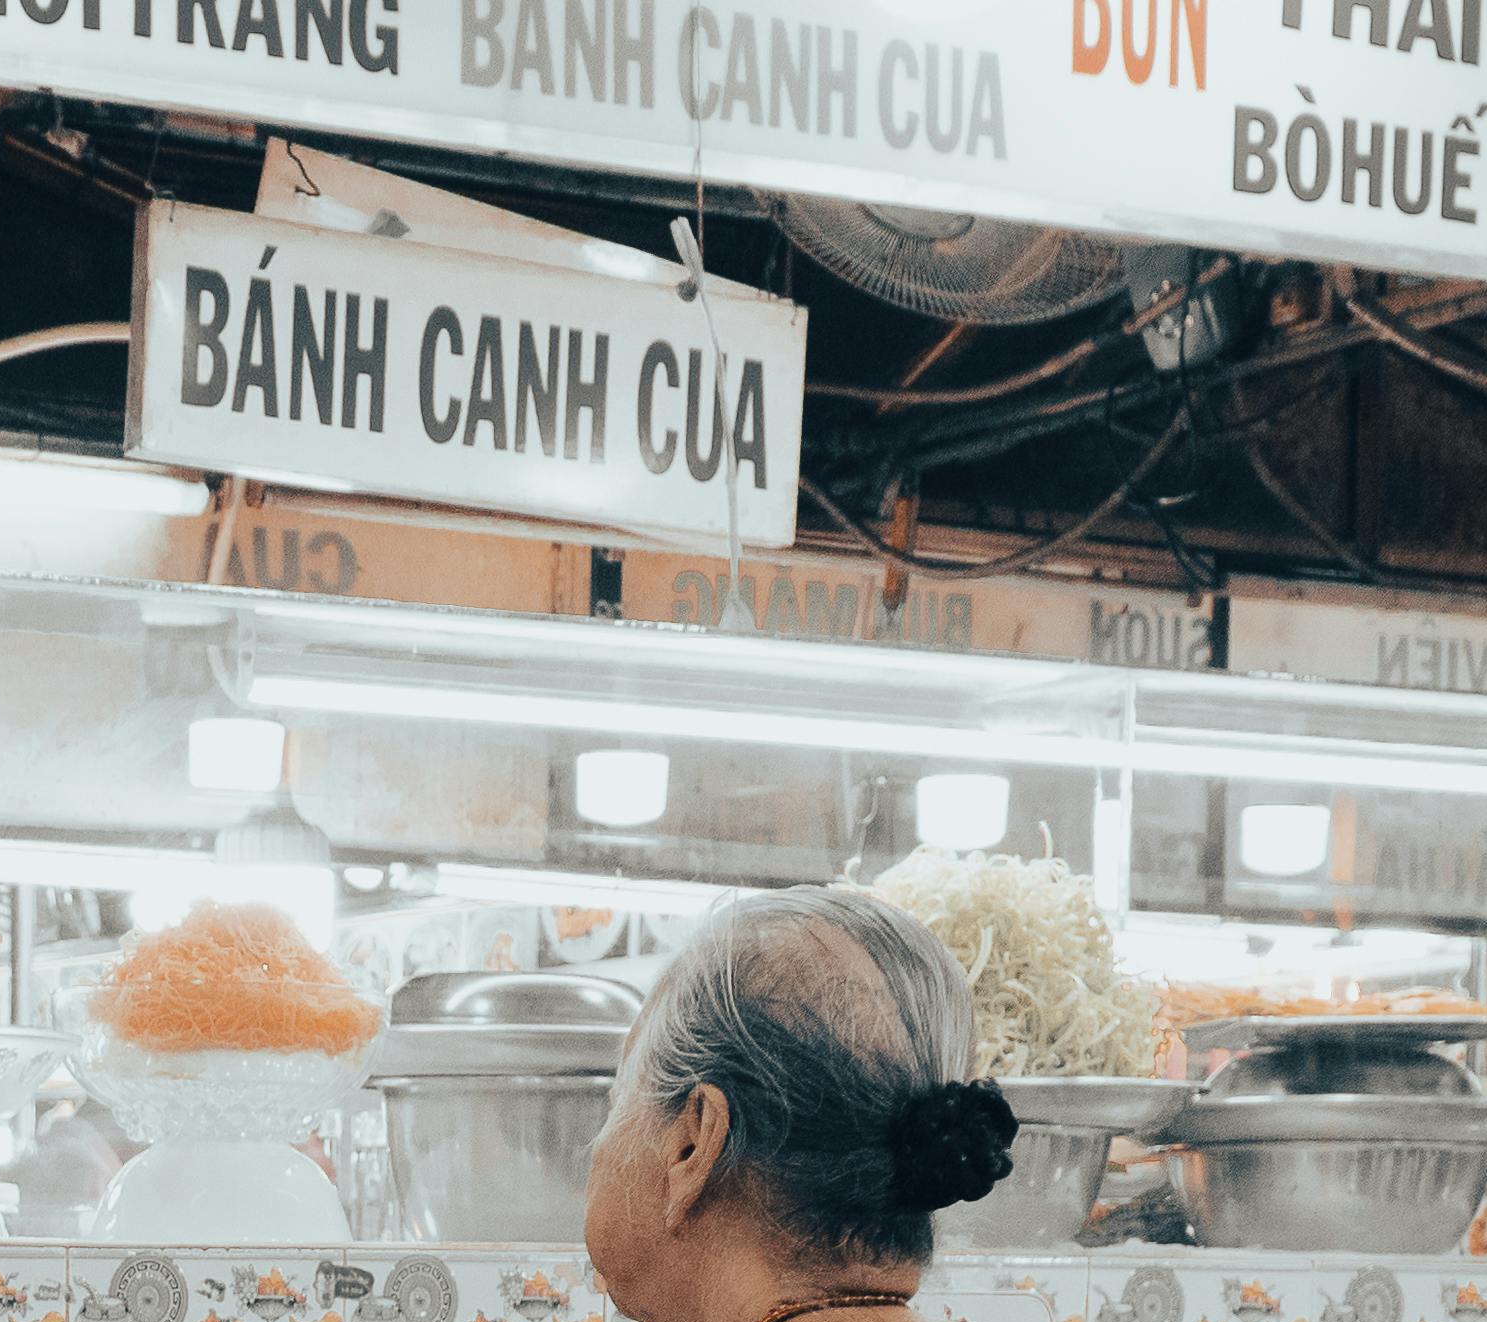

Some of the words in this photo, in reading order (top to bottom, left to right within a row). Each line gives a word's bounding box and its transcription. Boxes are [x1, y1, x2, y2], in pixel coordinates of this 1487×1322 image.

[678, 6, 858, 139] CANH
[877, 39, 1008, 161] CUA
[180, 244, 390, 433] BÁNH
[419, 304, 611, 465] CANH
[636, 338, 768, 491] CUA
